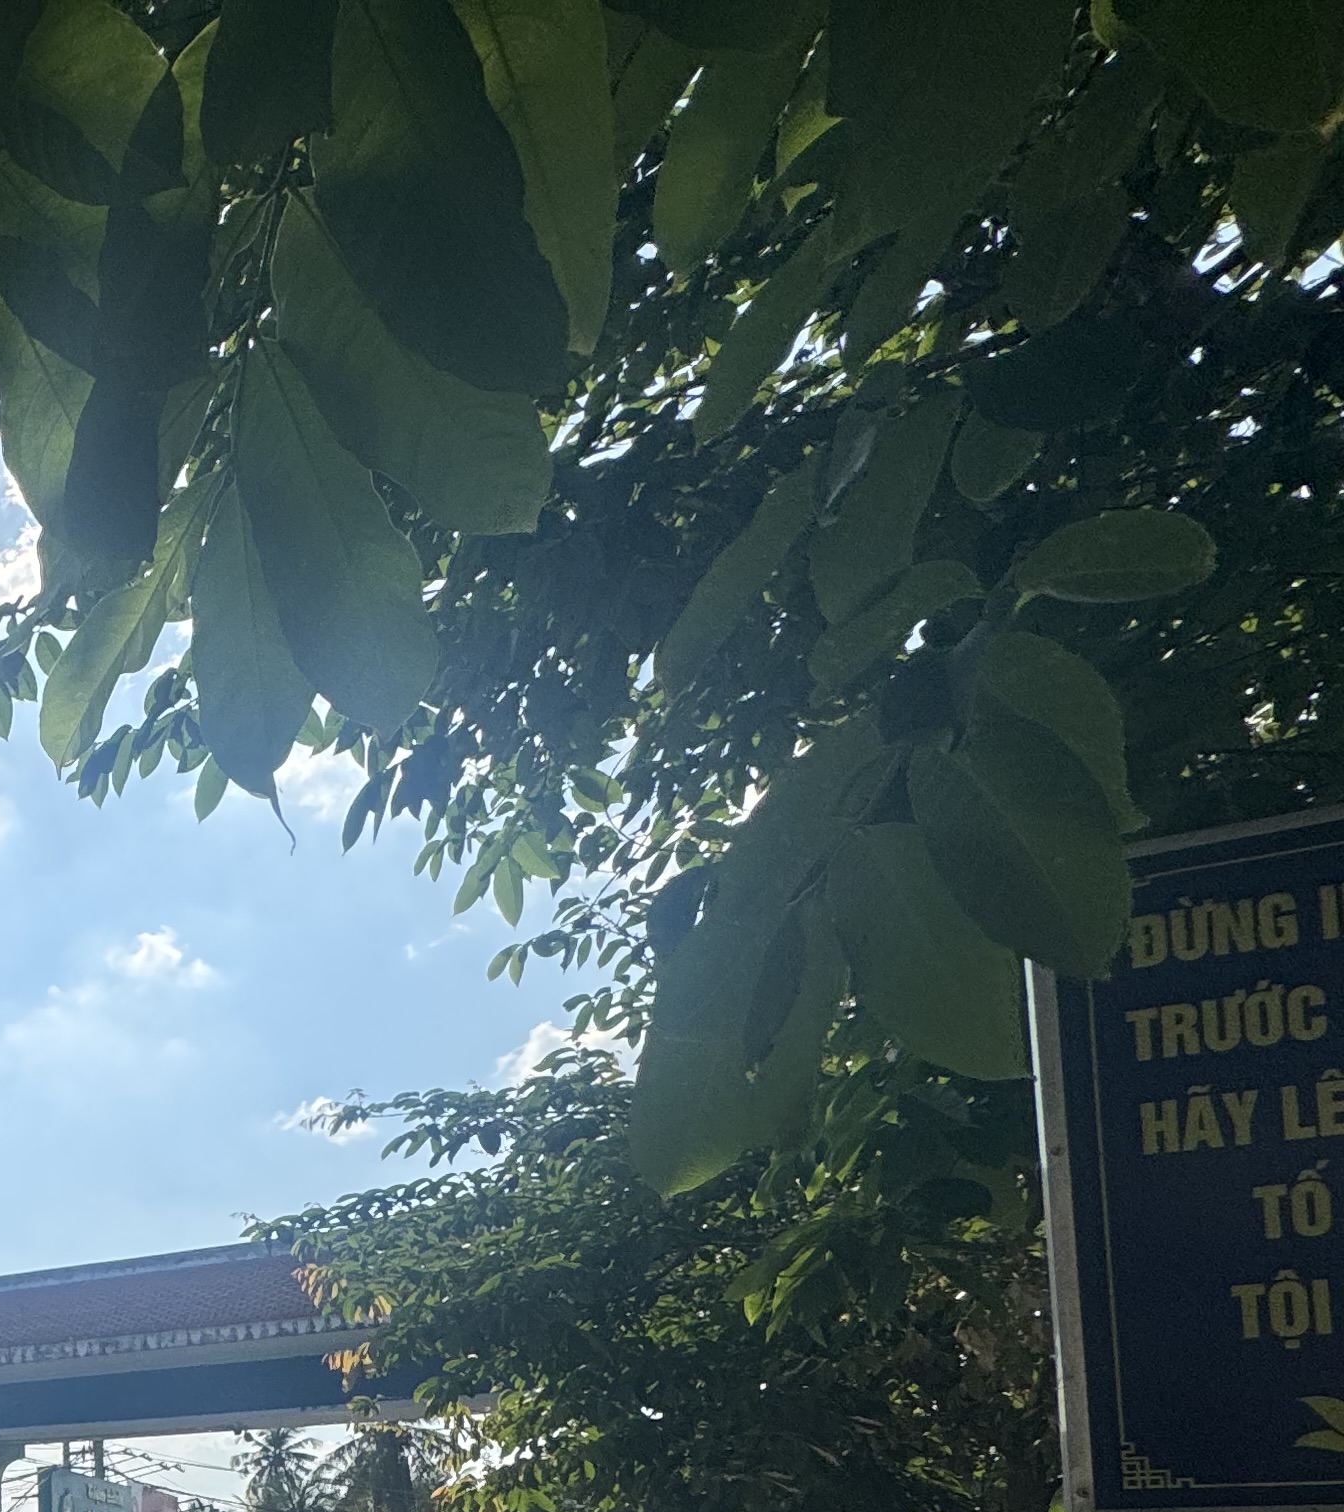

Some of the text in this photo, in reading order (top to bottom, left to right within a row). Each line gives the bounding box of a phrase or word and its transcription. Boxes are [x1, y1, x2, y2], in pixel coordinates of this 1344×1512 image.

[1128, 894, 1299, 969] ĐỪNG
[1125, 979, 1328, 1062] TRƯỚC
[1139, 1085, 1258, 1155] HÃY
[1252, 1159, 1333, 1240] TỐ
[1230, 1270, 1335, 1349] TỘI
